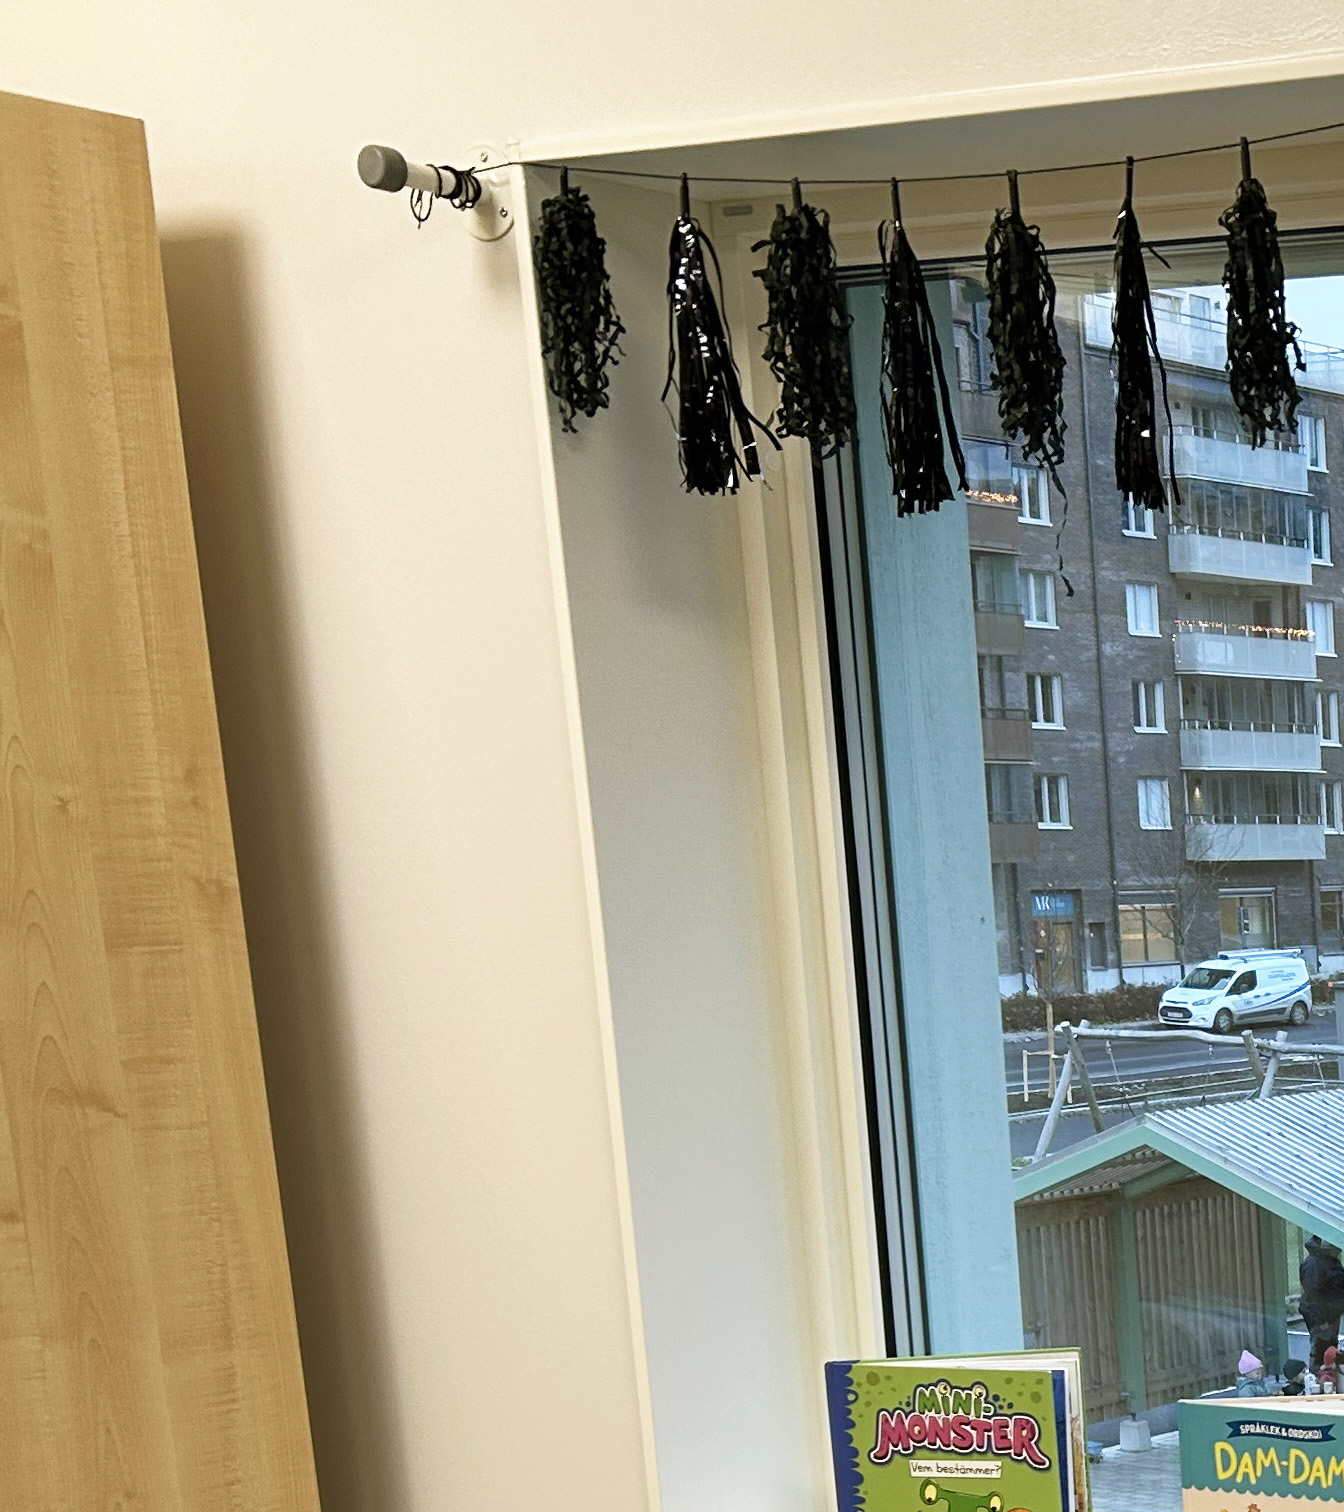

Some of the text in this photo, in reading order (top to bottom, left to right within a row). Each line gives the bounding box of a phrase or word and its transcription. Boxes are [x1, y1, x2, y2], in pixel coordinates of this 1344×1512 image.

[870, 1411, 1049, 1467] MONSTER
[911, 1462, 1002, 1476] Vem bestämmer?
